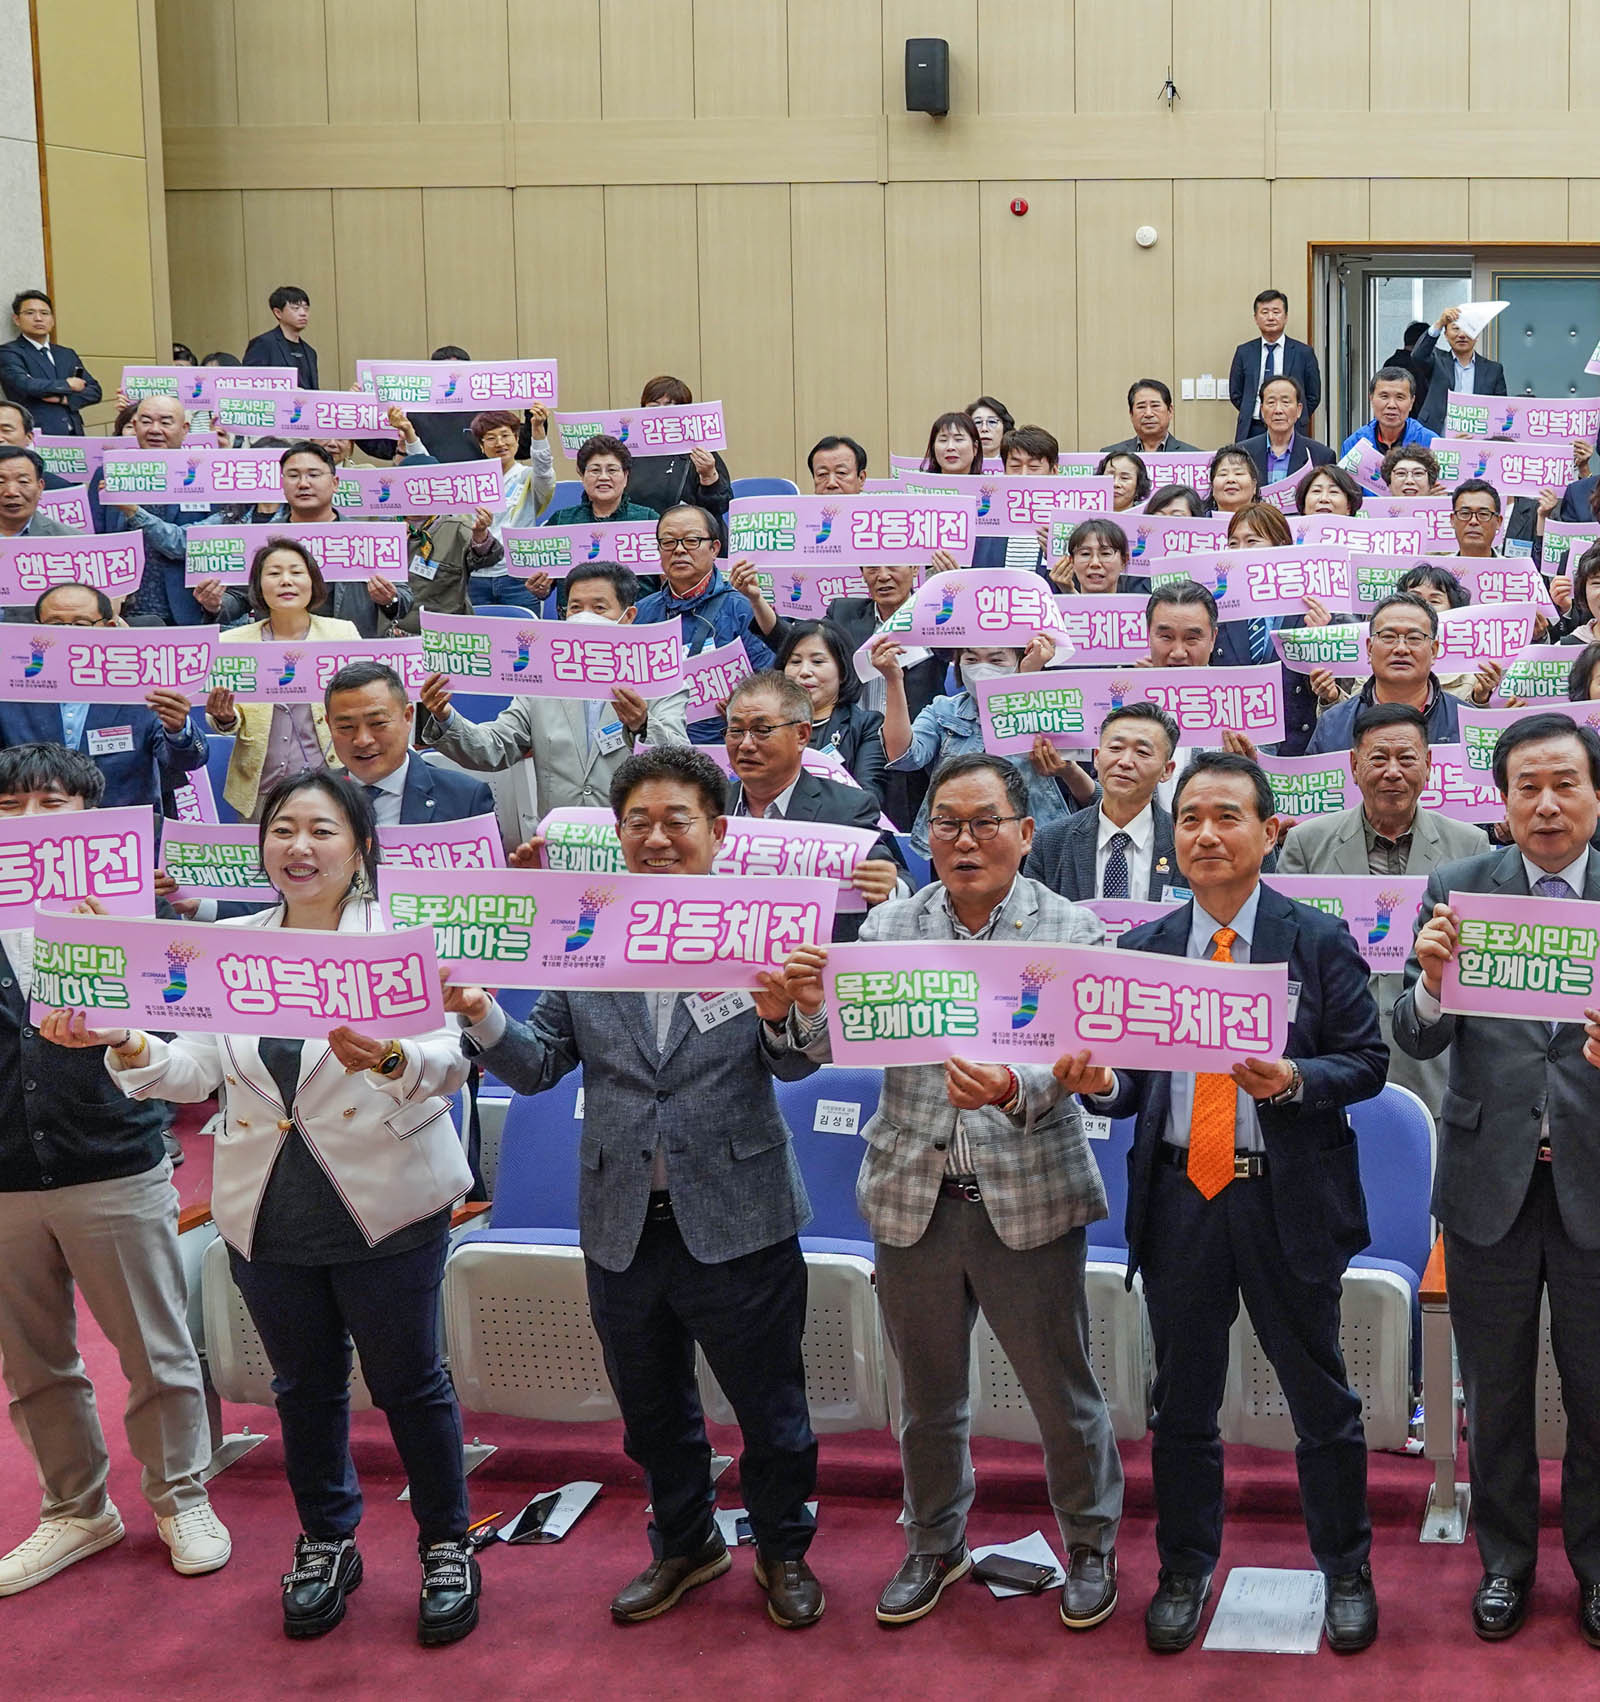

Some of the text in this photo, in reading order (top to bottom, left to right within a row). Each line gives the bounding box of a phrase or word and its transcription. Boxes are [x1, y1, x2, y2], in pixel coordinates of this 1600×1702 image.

[371, 376, 432, 391] 목포시민과
[380, 387, 429, 401] 함께하는
[471, 372, 553, 400] 행복체전
[220, 398, 276, 415] 목포시민과
[222, 411, 273, 425] 함께하는
[644, 415, 721, 445] 감동체전
[1526, 408, 1600, 437] 행복체전
[107, 462, 168, 478] 목포시민과
[107, 475, 165, 490] 함께하는
[211, 460, 283, 491] 감동체
[404, 472, 501, 507] 행복체전
[730, 512, 797, 533] 목포시민과
[851, 509, 968, 550] 감동체전
[509, 538, 571, 553] 목포시민과
[511, 549, 570, 565] 함께하는
[614, 532, 656, 563] 감동
[13, 546, 136, 591] 행복체전
[1246, 560, 1349, 600] 감동체전
[816, 576, 869, 600] 행복
[974, 586, 1066, 631] 행복체
[1062, 610, 1150, 650] 복체전
[68, 642, 211, 688] 감동체전
[550, 636, 682, 686] 감동체전
[1280, 641, 1358, 661] 함께하는
[988, 689, 1083, 716] 목포시민과
[1144, 682, 1277, 731] 감동체전
[992, 711, 1083, 738] 함께하는
[166, 841, 260, 866] 목포시민과
[382, 837, 496, 868] 복체전
[0, 831, 143, 907] 동체전
[167, 861, 269, 886] 함께하는
[389, 893, 538, 929] 목포시민과
[421, 923, 533, 961] 께하는
[624, 899, 821, 967] 감동체전
[1459, 920, 1600, 959] 목포시민과
[216, 952, 432, 1022] 행복체전
[836, 969, 980, 1003] 목포시민과
[1459, 951, 1596, 995] 함께하는
[838, 997, 978, 1041] 함께하는
[1072, 973, 1274, 1053] 행복체전
